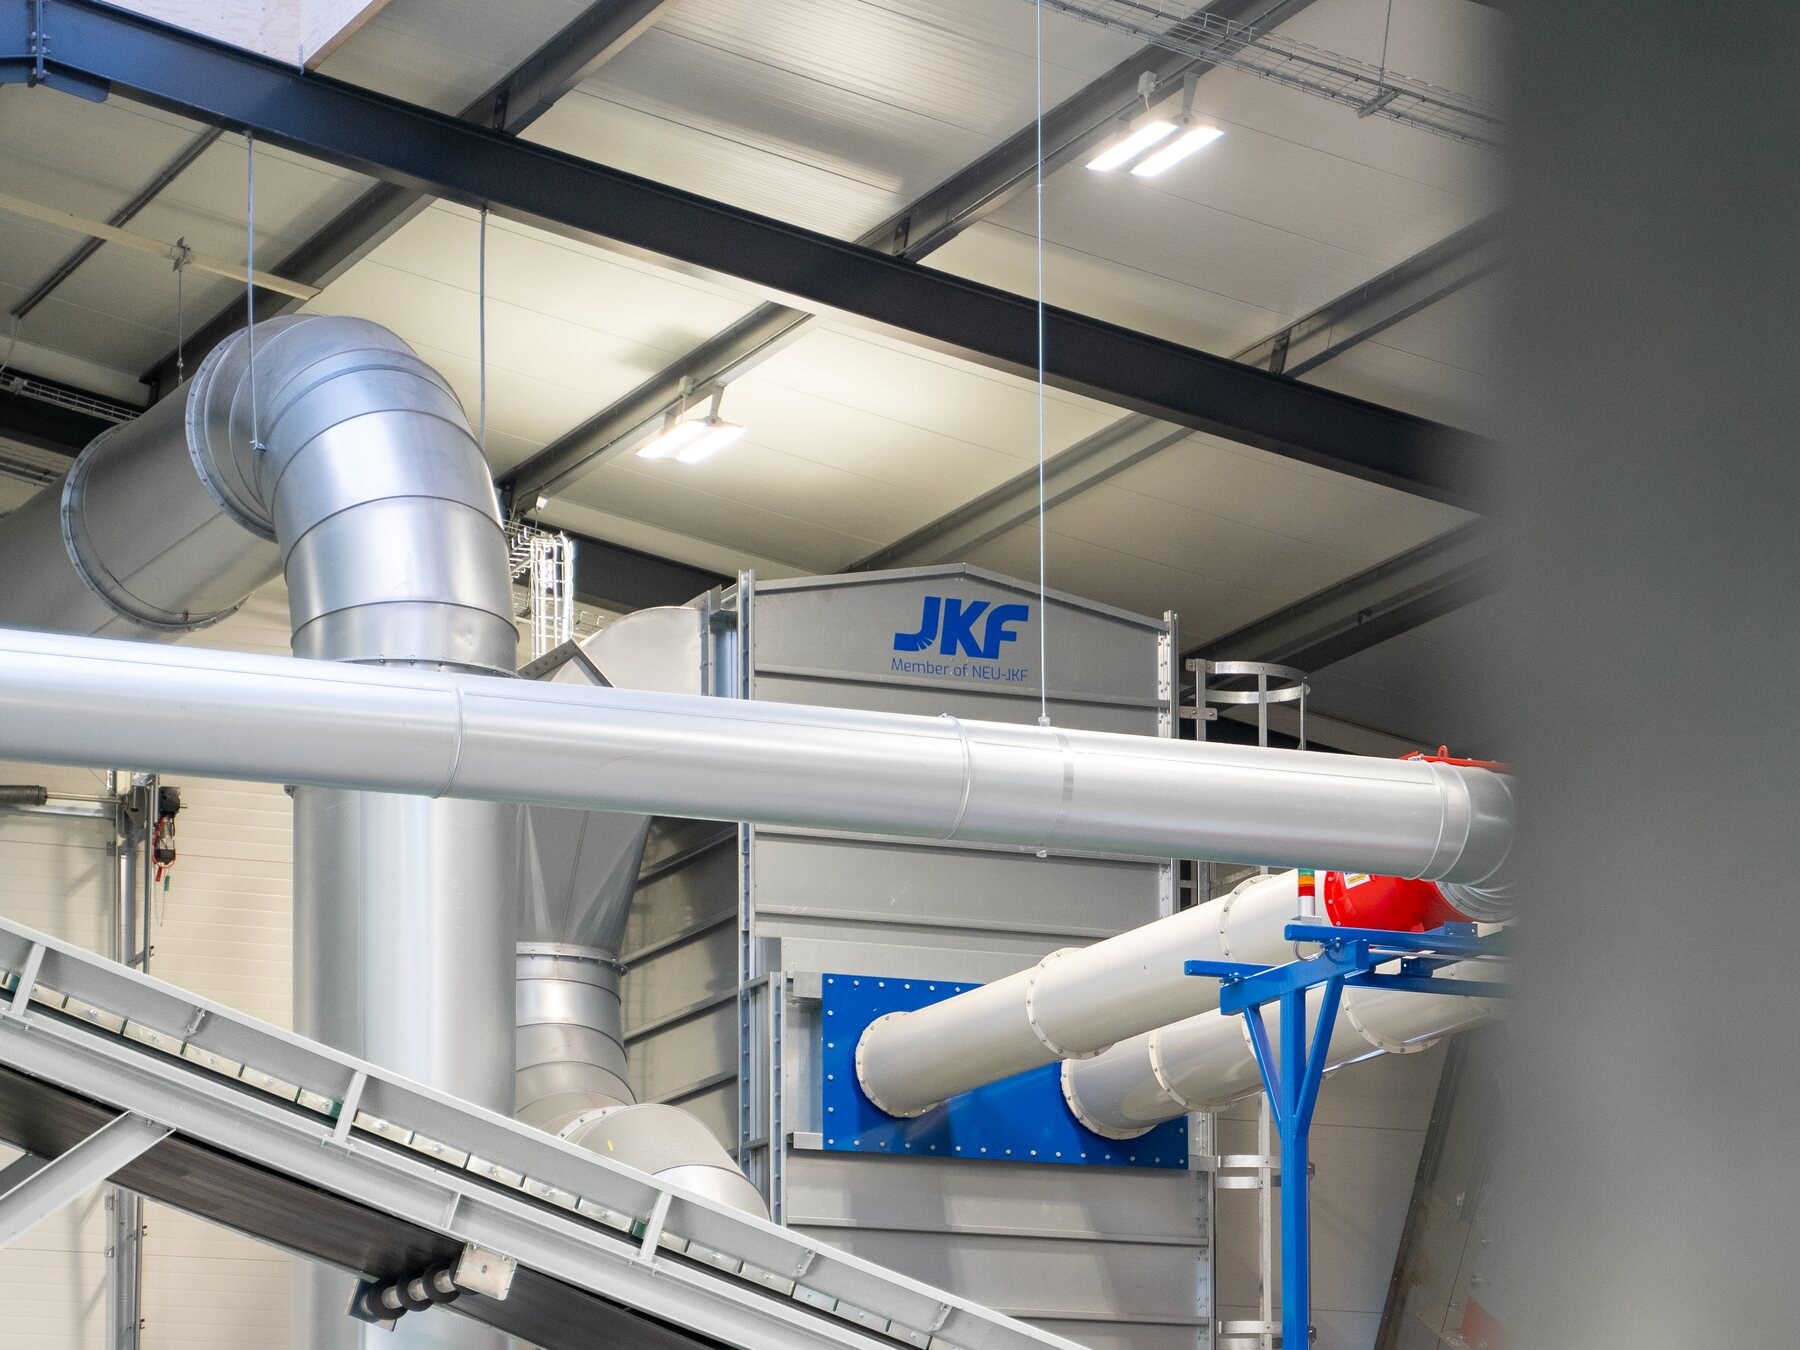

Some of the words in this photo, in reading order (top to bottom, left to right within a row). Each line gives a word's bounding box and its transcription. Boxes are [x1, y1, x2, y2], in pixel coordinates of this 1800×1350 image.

[893, 595, 1029, 660] JKF
[891, 657, 949, 675] Member
[953, 663, 969, 677] of
[972, 664, 1029, 682] NEU-JKF
